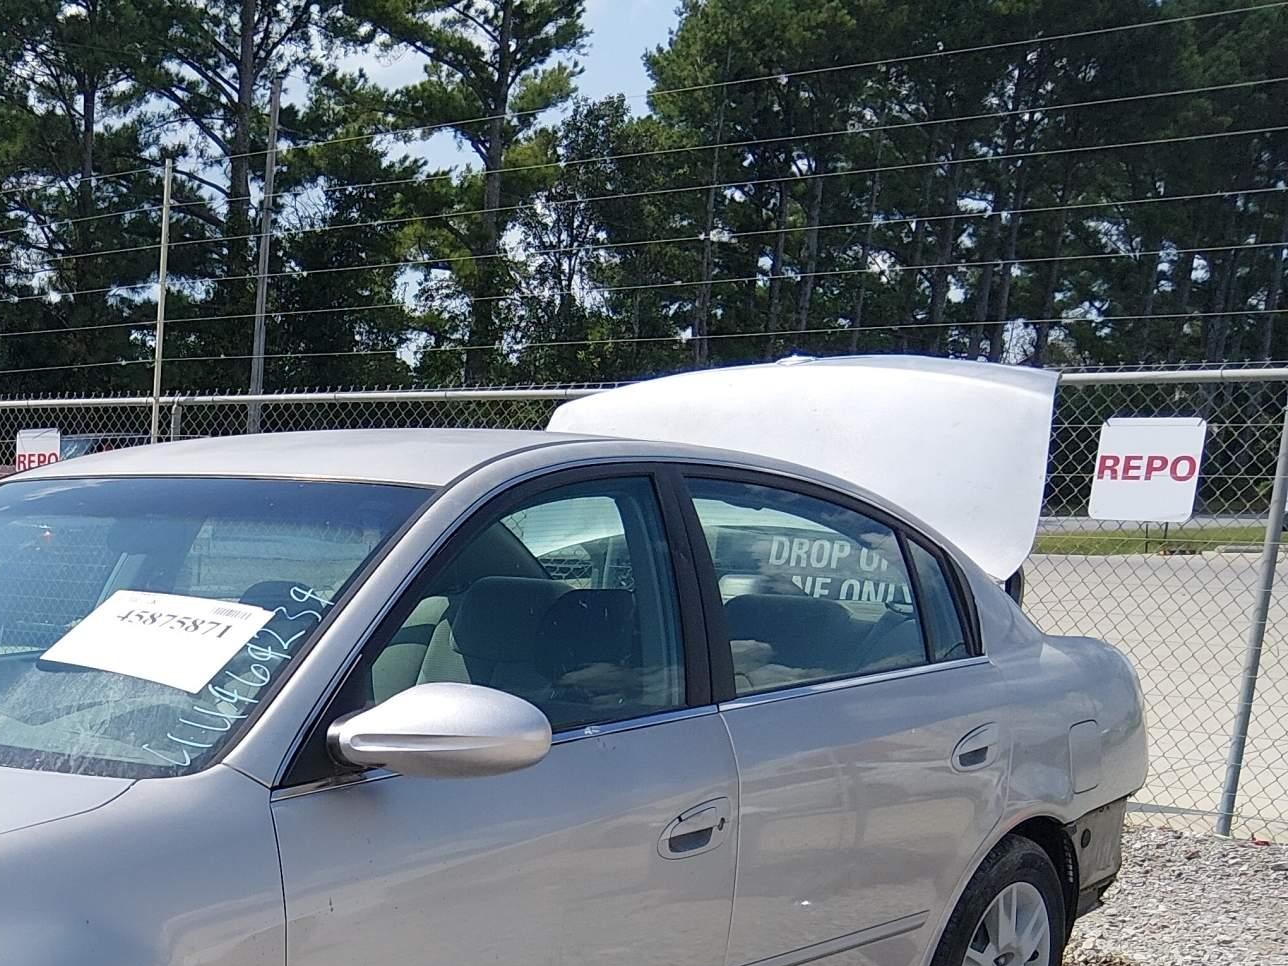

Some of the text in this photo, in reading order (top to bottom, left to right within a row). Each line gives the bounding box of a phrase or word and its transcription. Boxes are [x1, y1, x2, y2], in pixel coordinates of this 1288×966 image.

[17, 453, 59, 470] REPO
[1097, 455, 1197, 482] REPO
[769, 536, 851, 569] DROP
[117, 609, 233, 639] 45875871
